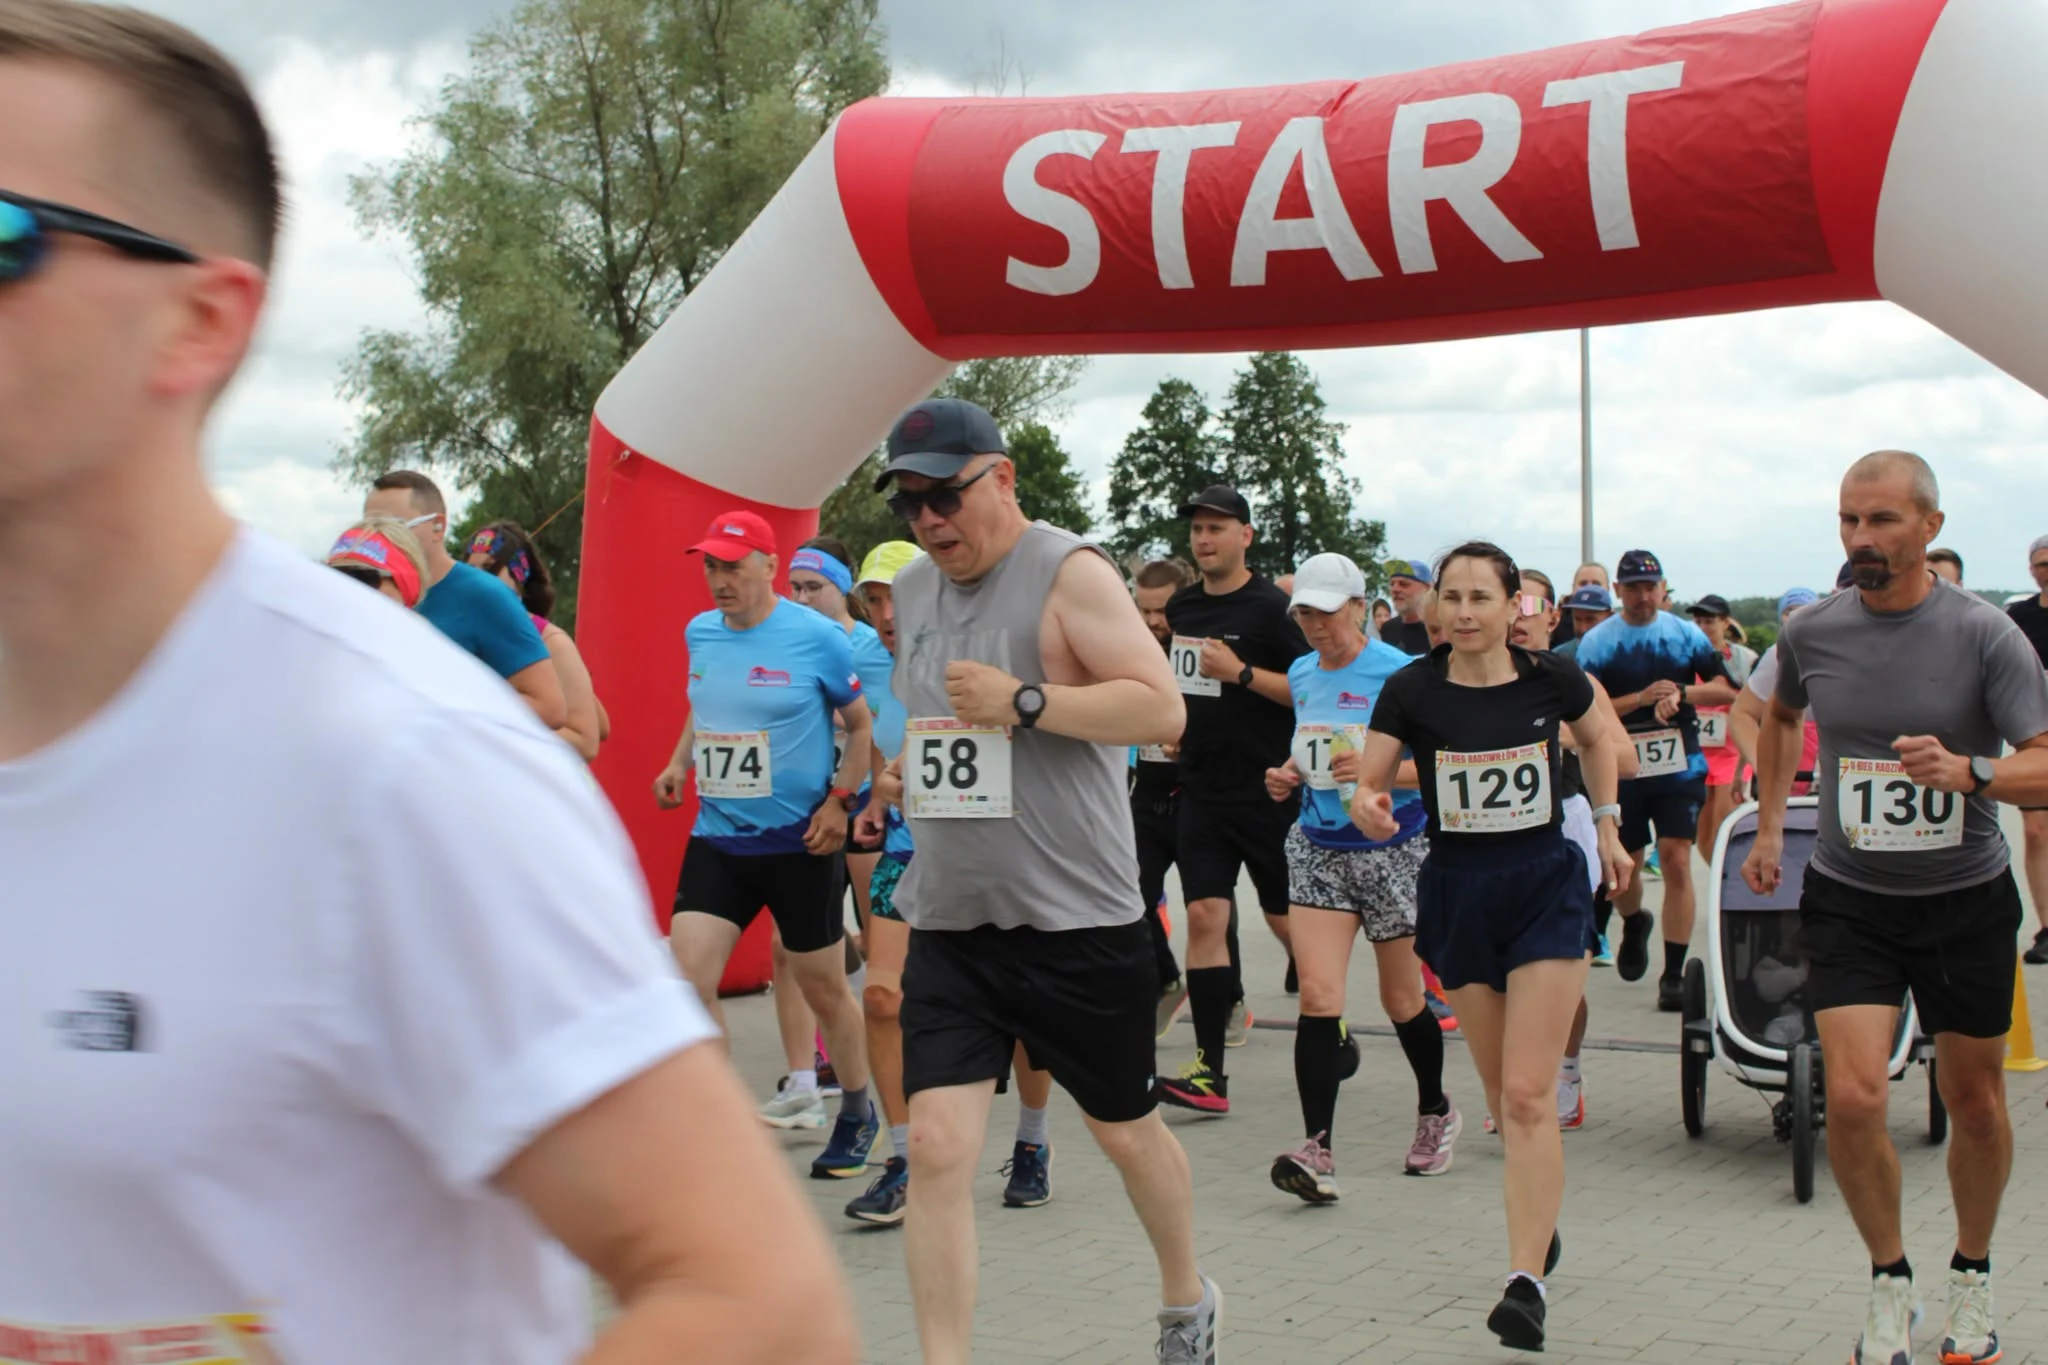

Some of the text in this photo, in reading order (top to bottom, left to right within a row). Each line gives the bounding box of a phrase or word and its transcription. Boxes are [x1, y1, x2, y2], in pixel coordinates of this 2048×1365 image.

[1002, 61, 1685, 297] START
[1173, 648, 1212, 679] 10
[702, 746, 763, 779] 174
[921, 737, 978, 790] 58
[1634, 738, 1677, 763] 157
[1857, 761, 1873, 772] BIEG
[1875, 762, 1906, 773] RADZIW
[1449, 763, 1540, 810] 129
[1853, 779, 1954, 826] 130
